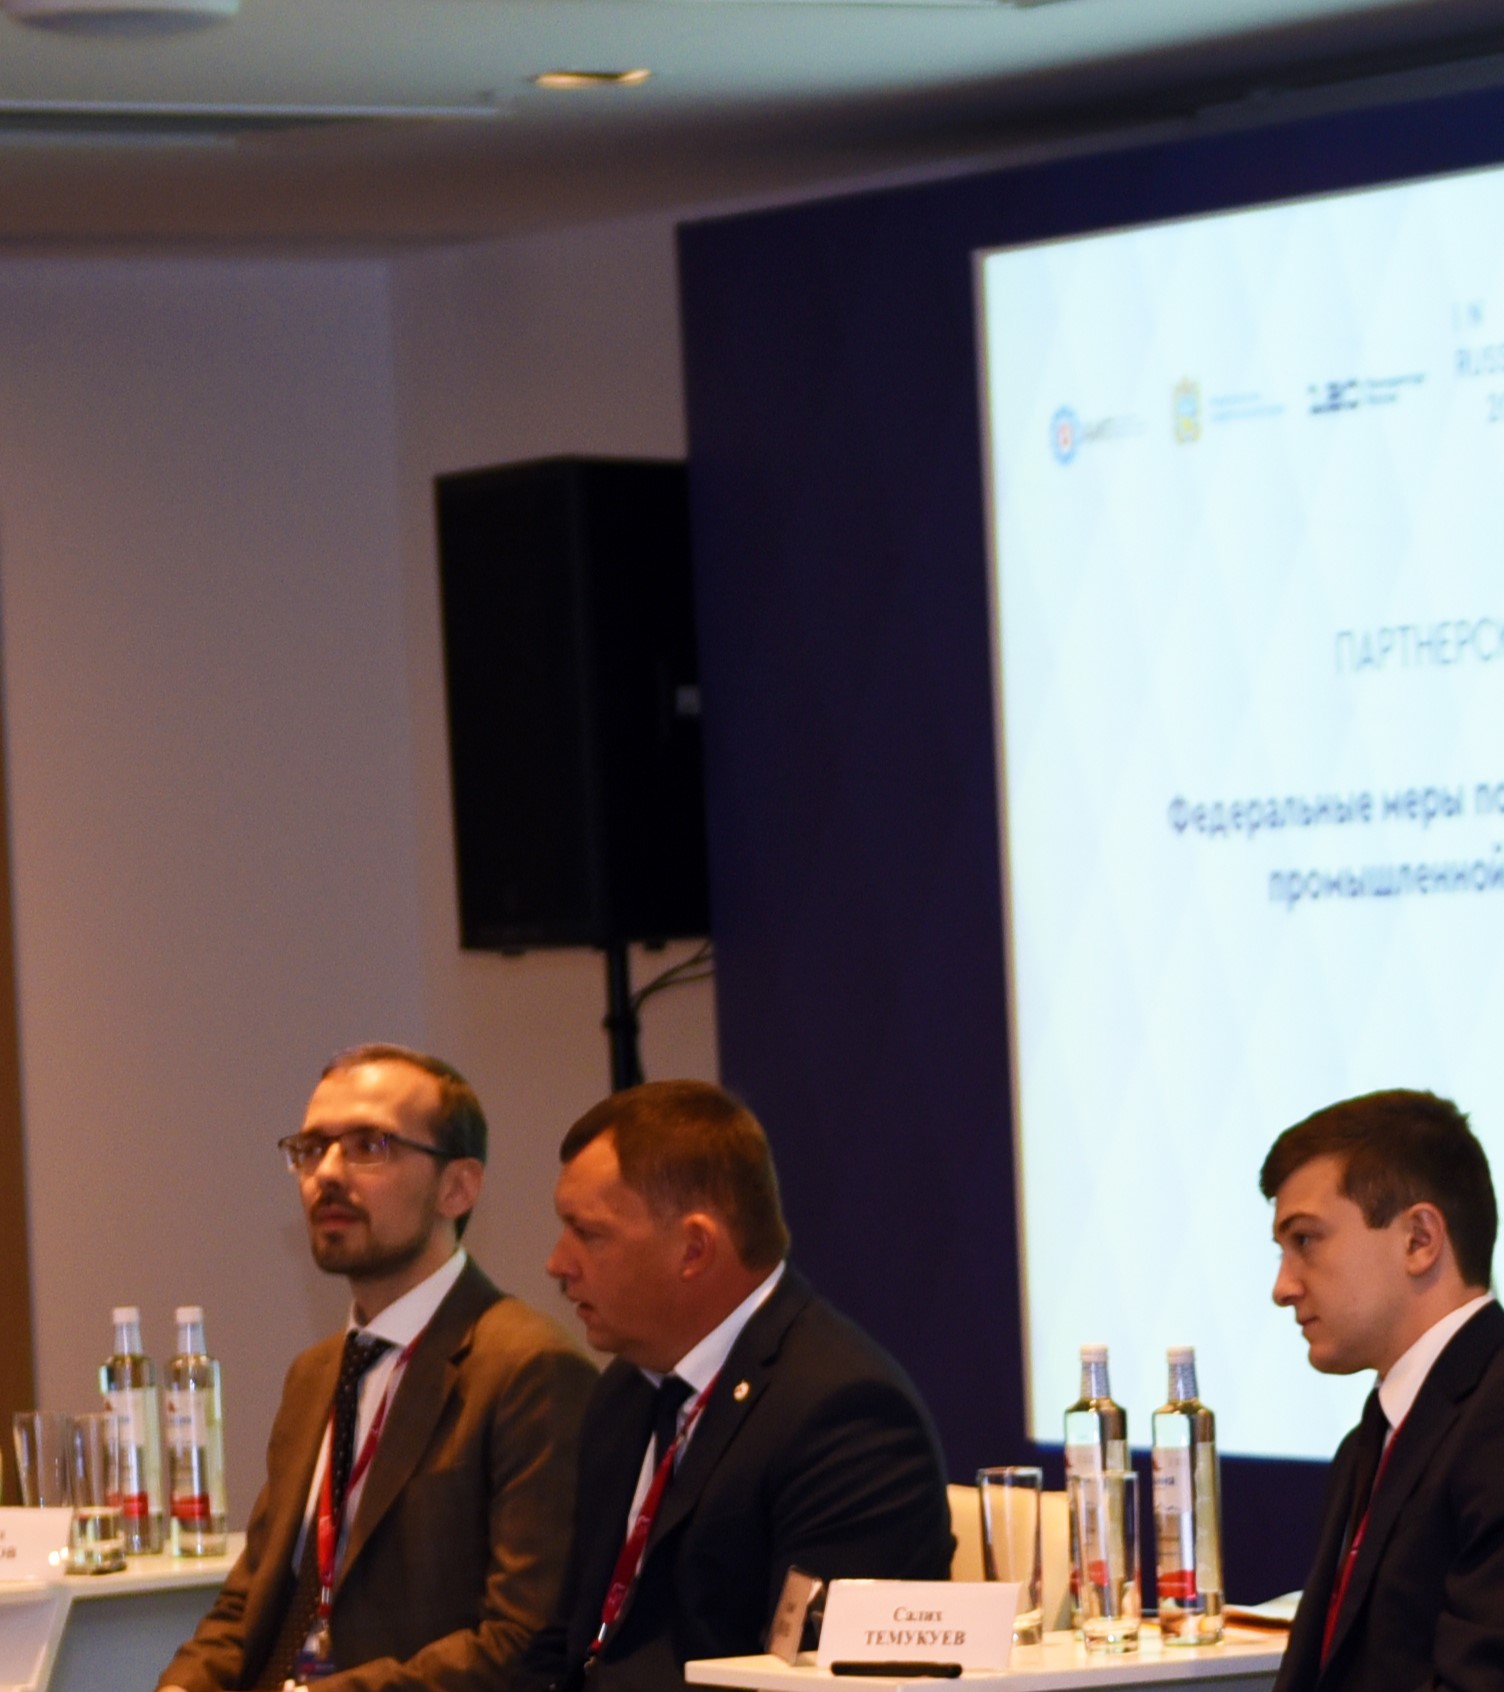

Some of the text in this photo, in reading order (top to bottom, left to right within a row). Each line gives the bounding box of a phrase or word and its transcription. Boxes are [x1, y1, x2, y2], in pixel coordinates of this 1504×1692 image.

[1168, 788, 1374, 842] Федеральные
[1383, 778, 1465, 828] меры
[893, 1606, 943, 1623] Салих
[864, 1629, 967, 1647] ТЕМУКУЕВ
